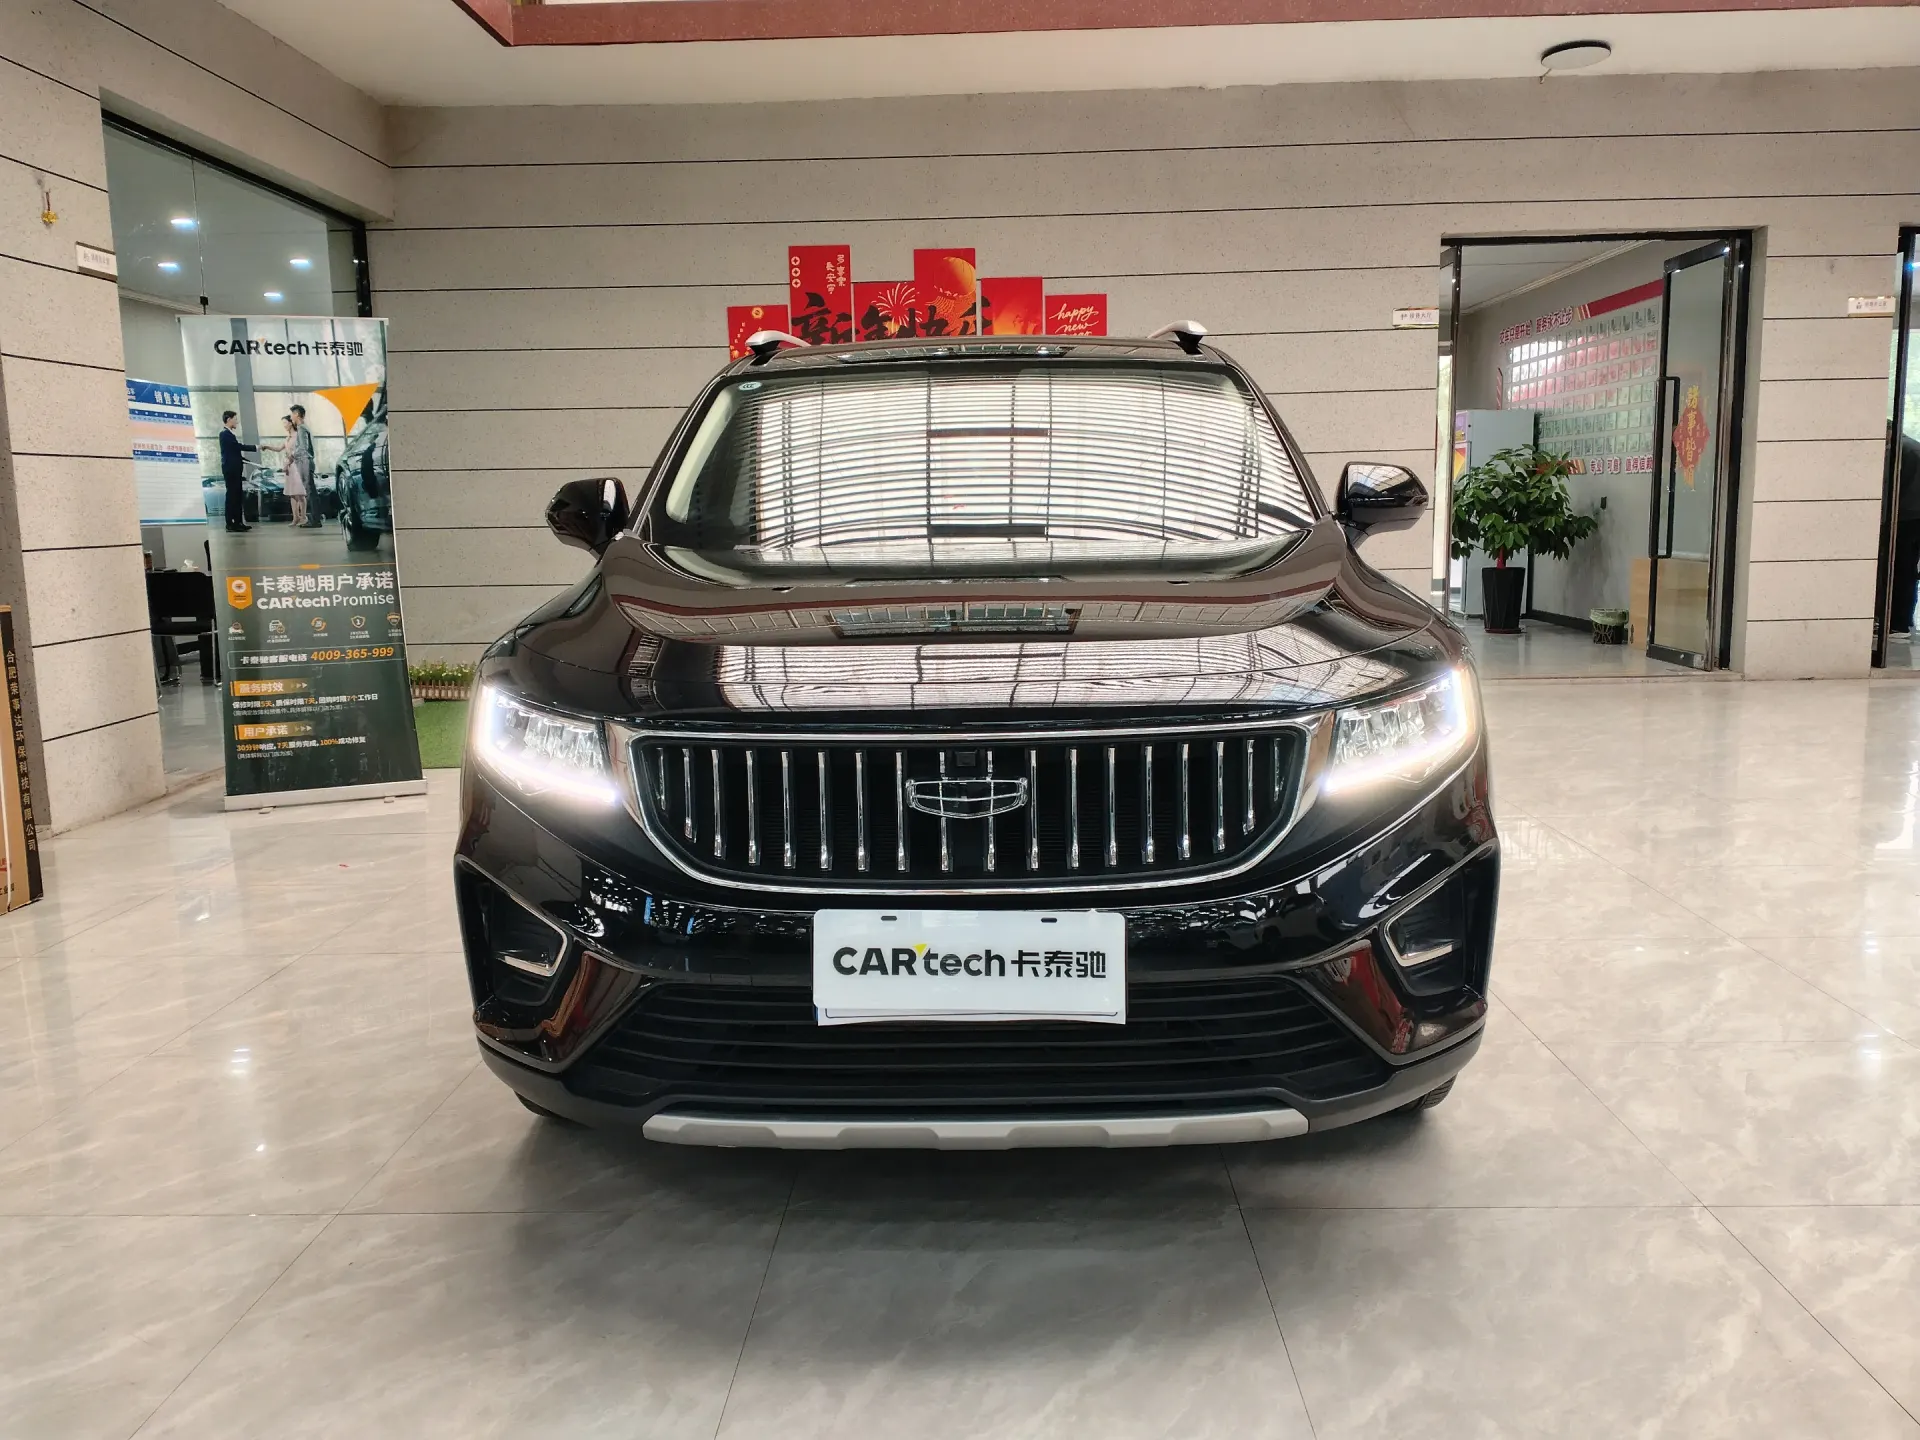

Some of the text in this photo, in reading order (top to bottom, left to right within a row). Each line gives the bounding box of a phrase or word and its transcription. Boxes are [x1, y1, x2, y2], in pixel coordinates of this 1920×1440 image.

[1049, 303, 1099, 323] happy
[1055, 321, 1099, 334] new
[214, 338, 310, 356] CARtech
[256, 571, 394, 594] 卡泰驰用户承诺
[256, 595, 331, 610] CARtech
[332, 591, 395, 607] Promise
[310, 646, 394, 662] 4009-365-999
[244, 724, 288, 737] 用户承诺
[832, 946, 1107, 978] CARtech 卡泰驰
